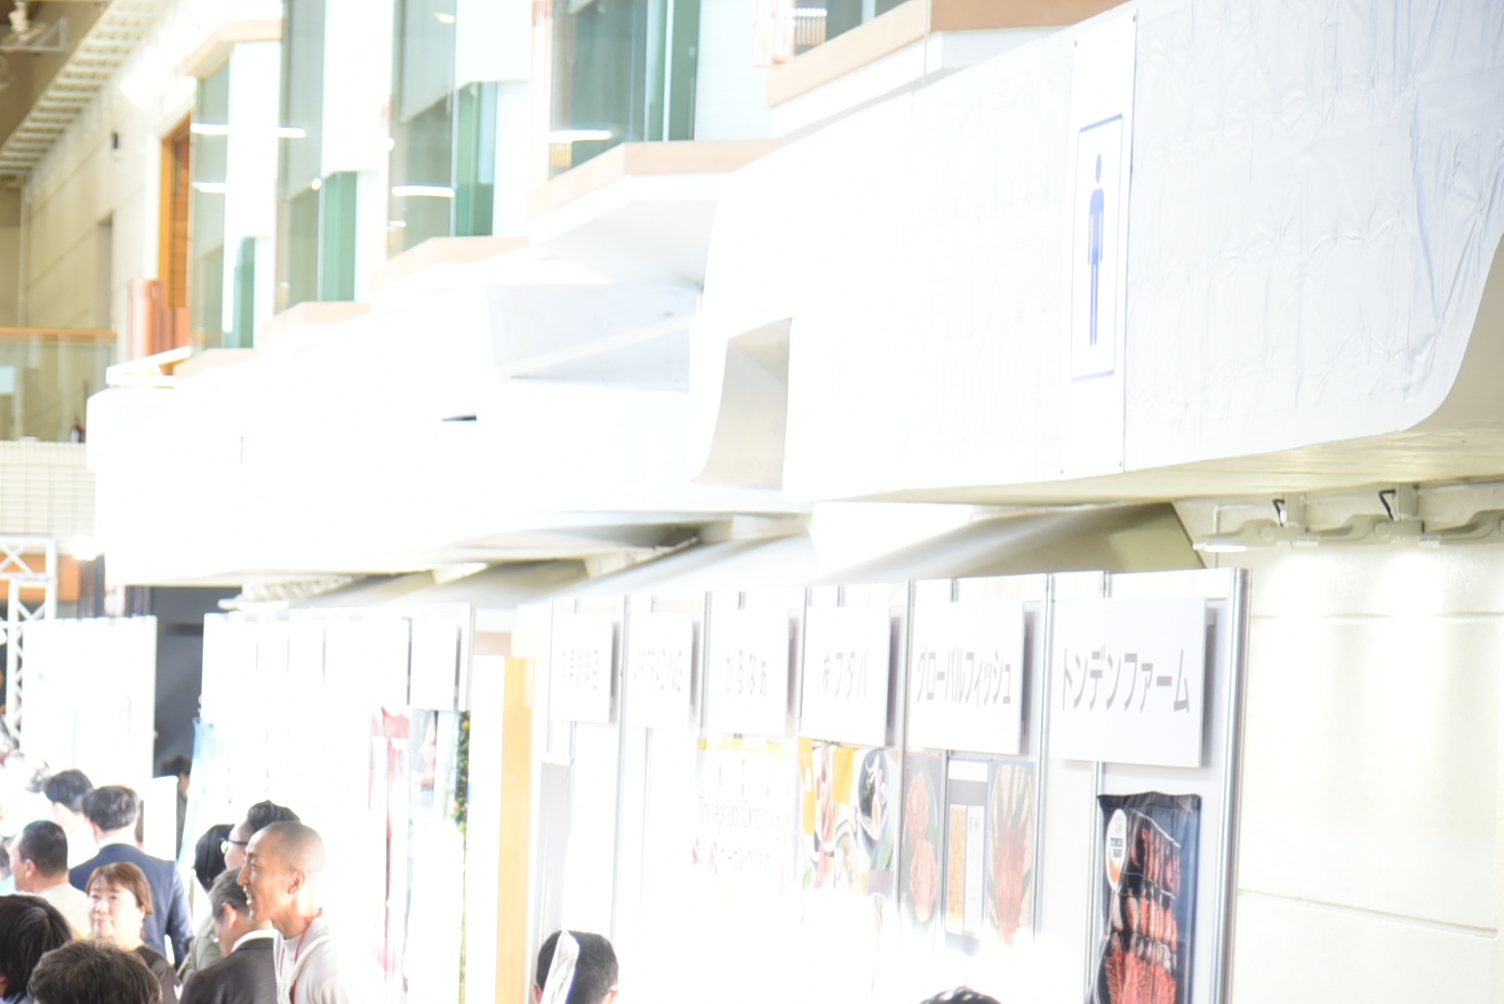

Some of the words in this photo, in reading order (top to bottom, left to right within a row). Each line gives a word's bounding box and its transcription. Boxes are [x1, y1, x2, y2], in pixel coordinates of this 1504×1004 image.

[917, 643, 1011, 706] グローバルフィッシュ
[1062, 644, 1191, 714] トンデンファーム
